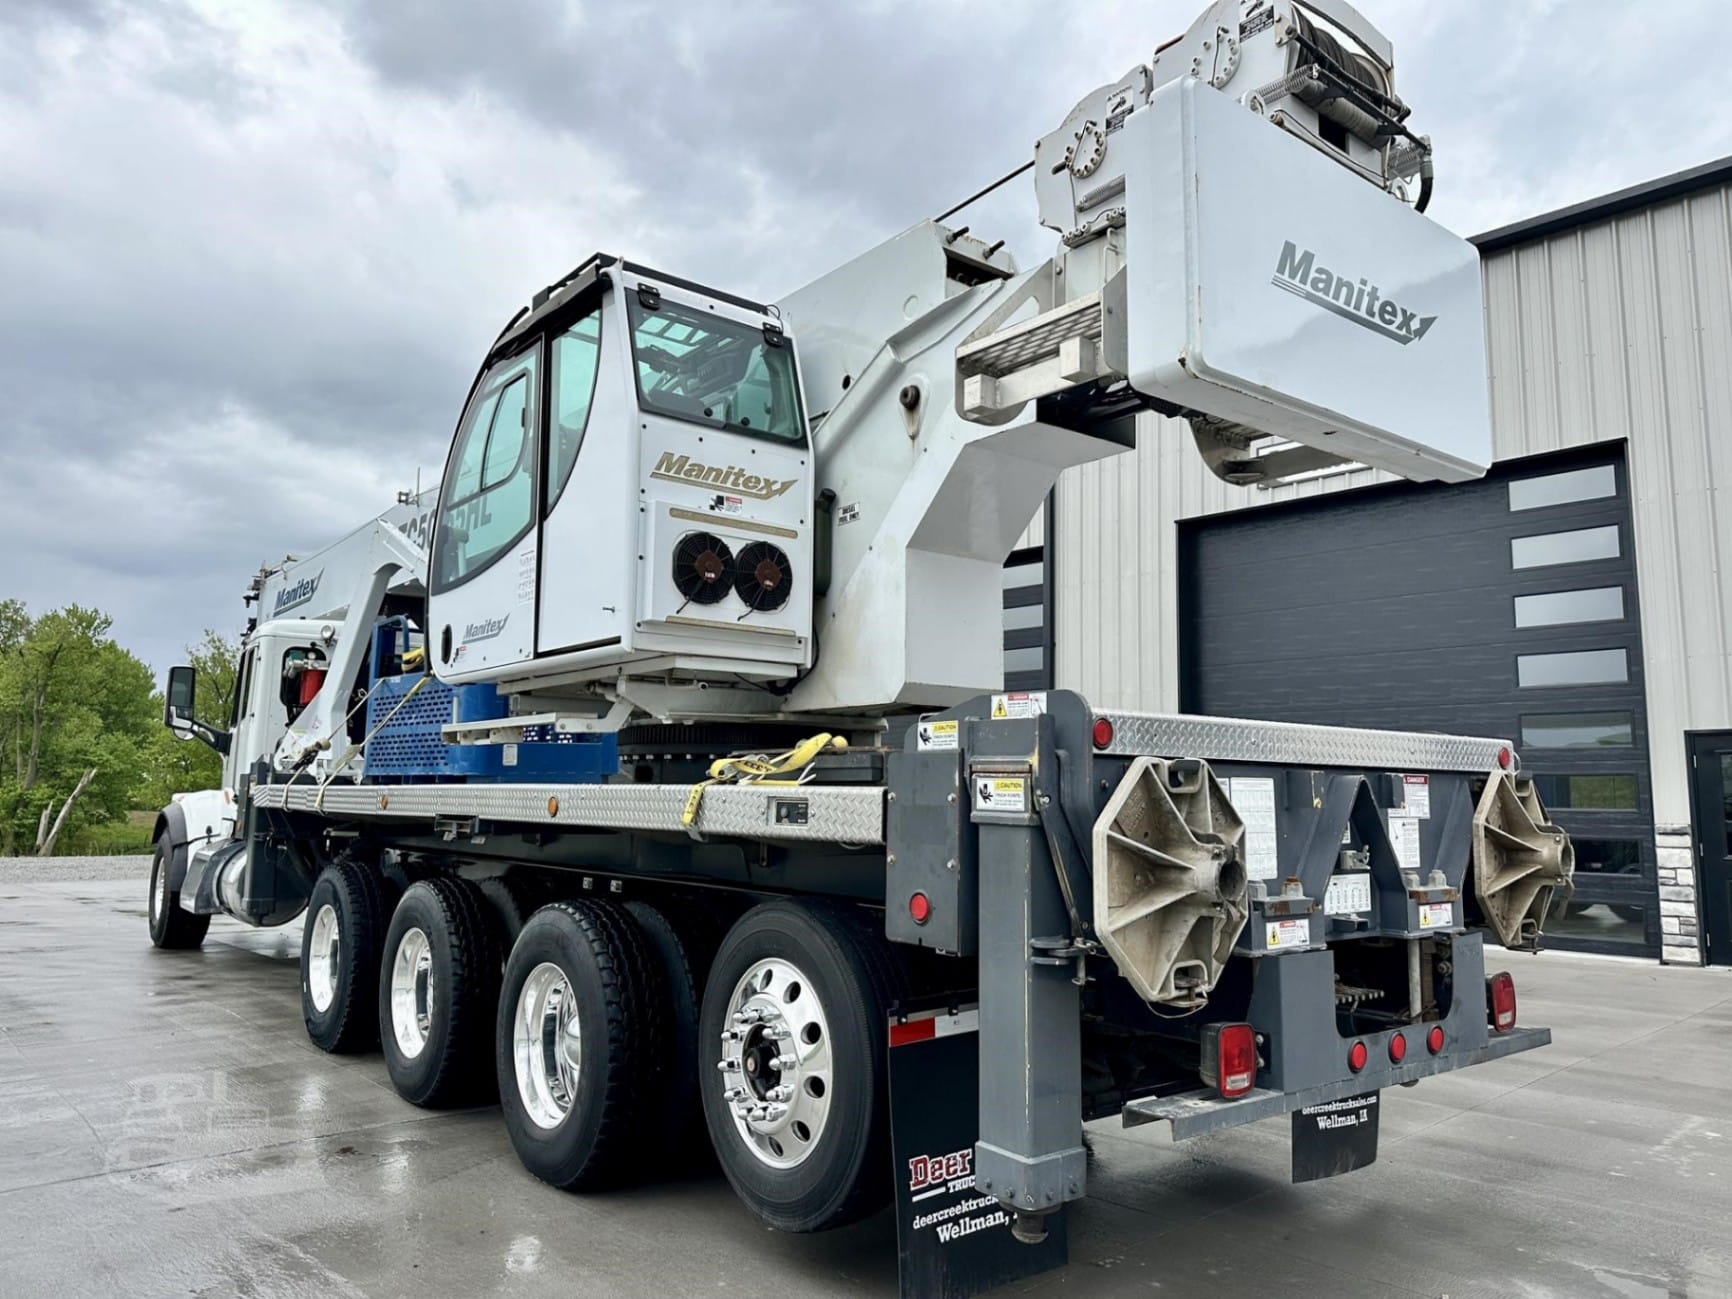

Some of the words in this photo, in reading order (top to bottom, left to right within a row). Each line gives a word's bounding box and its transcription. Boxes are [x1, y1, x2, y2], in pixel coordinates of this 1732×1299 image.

[1275, 240, 1417, 336] Manitex
[654, 451, 779, 493] Manitex
[274, 577, 317, 611] Manitex
[463, 617, 503, 640] Manitex
[1316, 1113, 1359, 1131] Wellman,
[909, 1148, 973, 1192] Deer
[936, 1210, 1010, 1244] Wellman,
